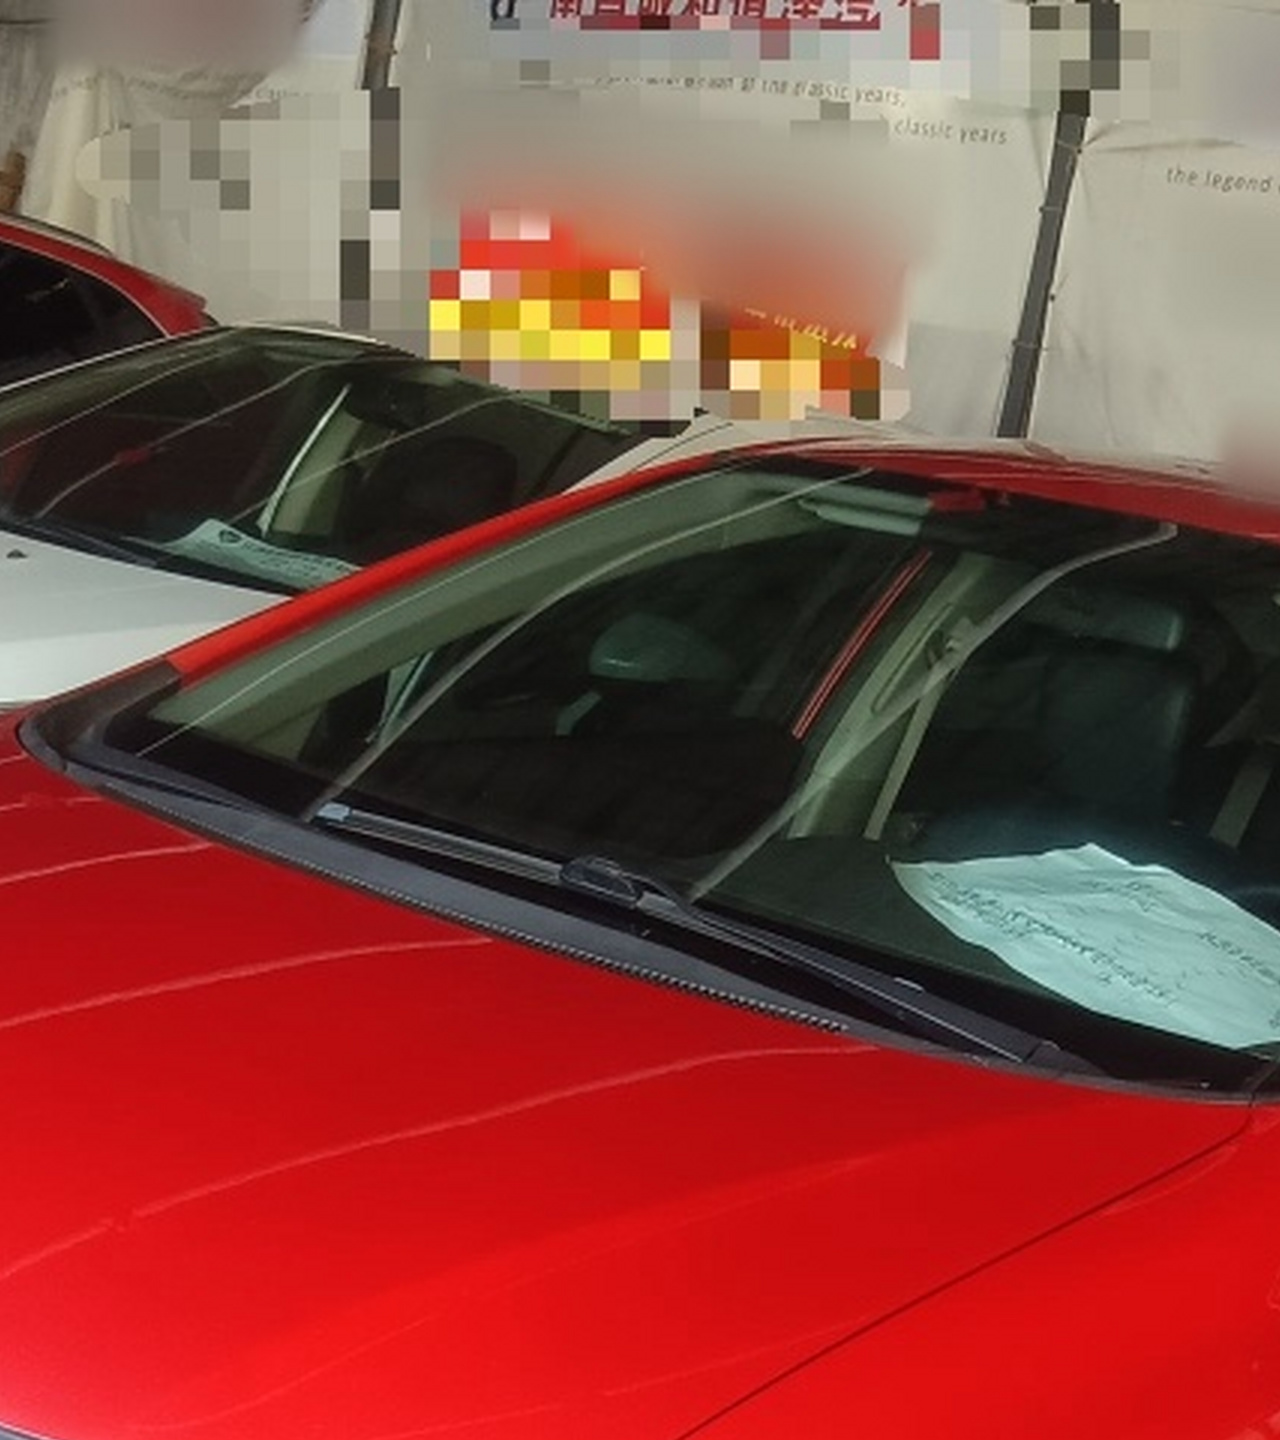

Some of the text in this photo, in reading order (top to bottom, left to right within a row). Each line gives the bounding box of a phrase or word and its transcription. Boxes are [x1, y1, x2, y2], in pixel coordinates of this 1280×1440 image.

[894, 117, 1008, 145] classic years
[1166, 164, 1198, 186] the
[1206, 170, 1272, 193] legend
